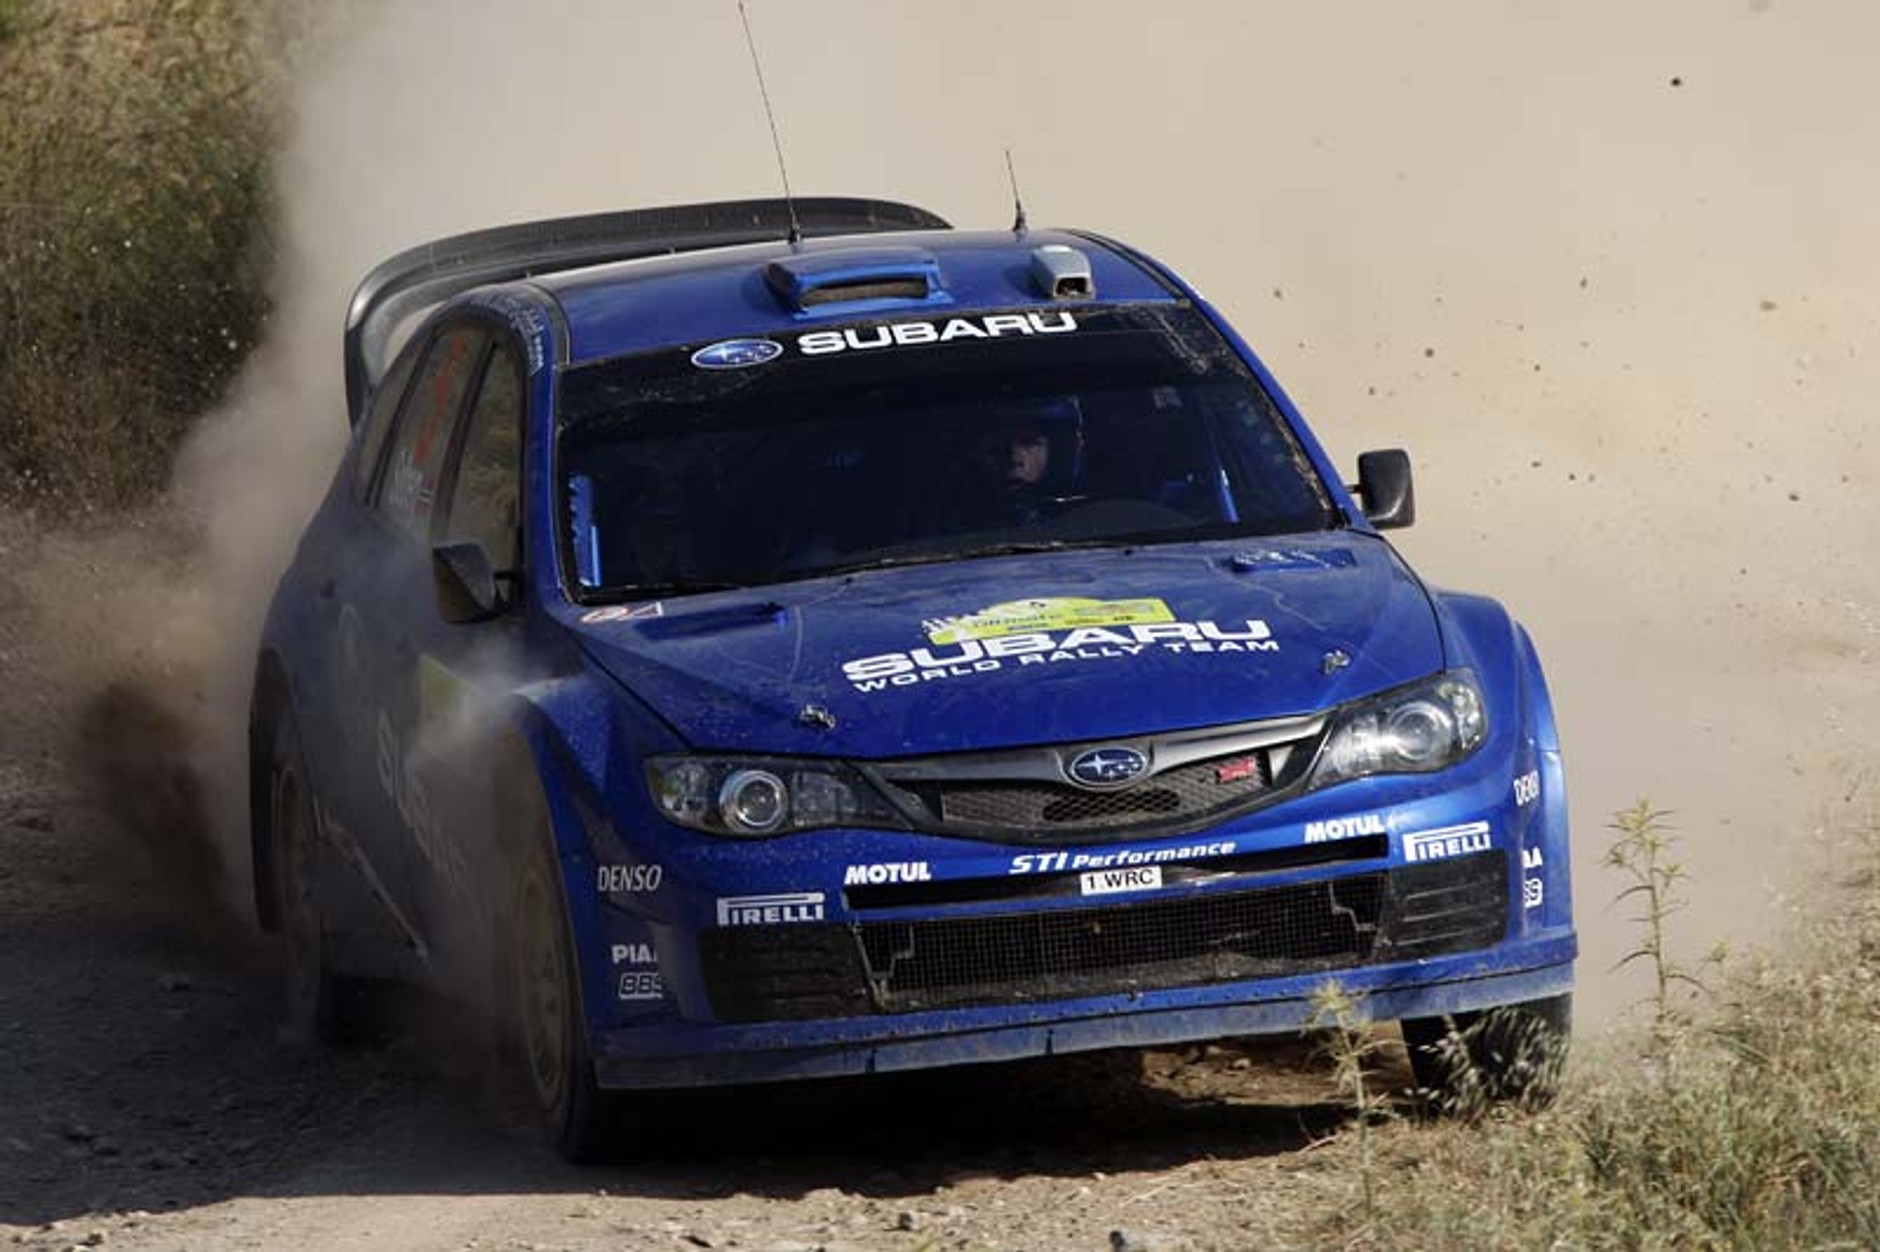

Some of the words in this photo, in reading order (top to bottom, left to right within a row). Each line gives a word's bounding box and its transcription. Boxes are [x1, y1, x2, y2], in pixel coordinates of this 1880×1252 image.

[799, 310, 1078, 355] SUBARU
[842, 619, 1272, 681] SUBARU
[854, 660, 1002, 692] WORLD
[1019, 643, 1144, 666] RALLY
[1163, 640, 1280, 653] TEAM
[1304, 815, 1386, 844] MOTUL
[1402, 821, 1491, 862] PIRELLI
[845, 862, 932, 885] MOTUL
[1009, 853, 1068, 875] STI
[1072, 842, 1236, 869] Performance
[597, 864, 662, 892] DENSO
[1104, 868, 1154, 888] WRC
[717, 892, 825, 926] PIRELLI
[611, 944, 659, 965] PIA
